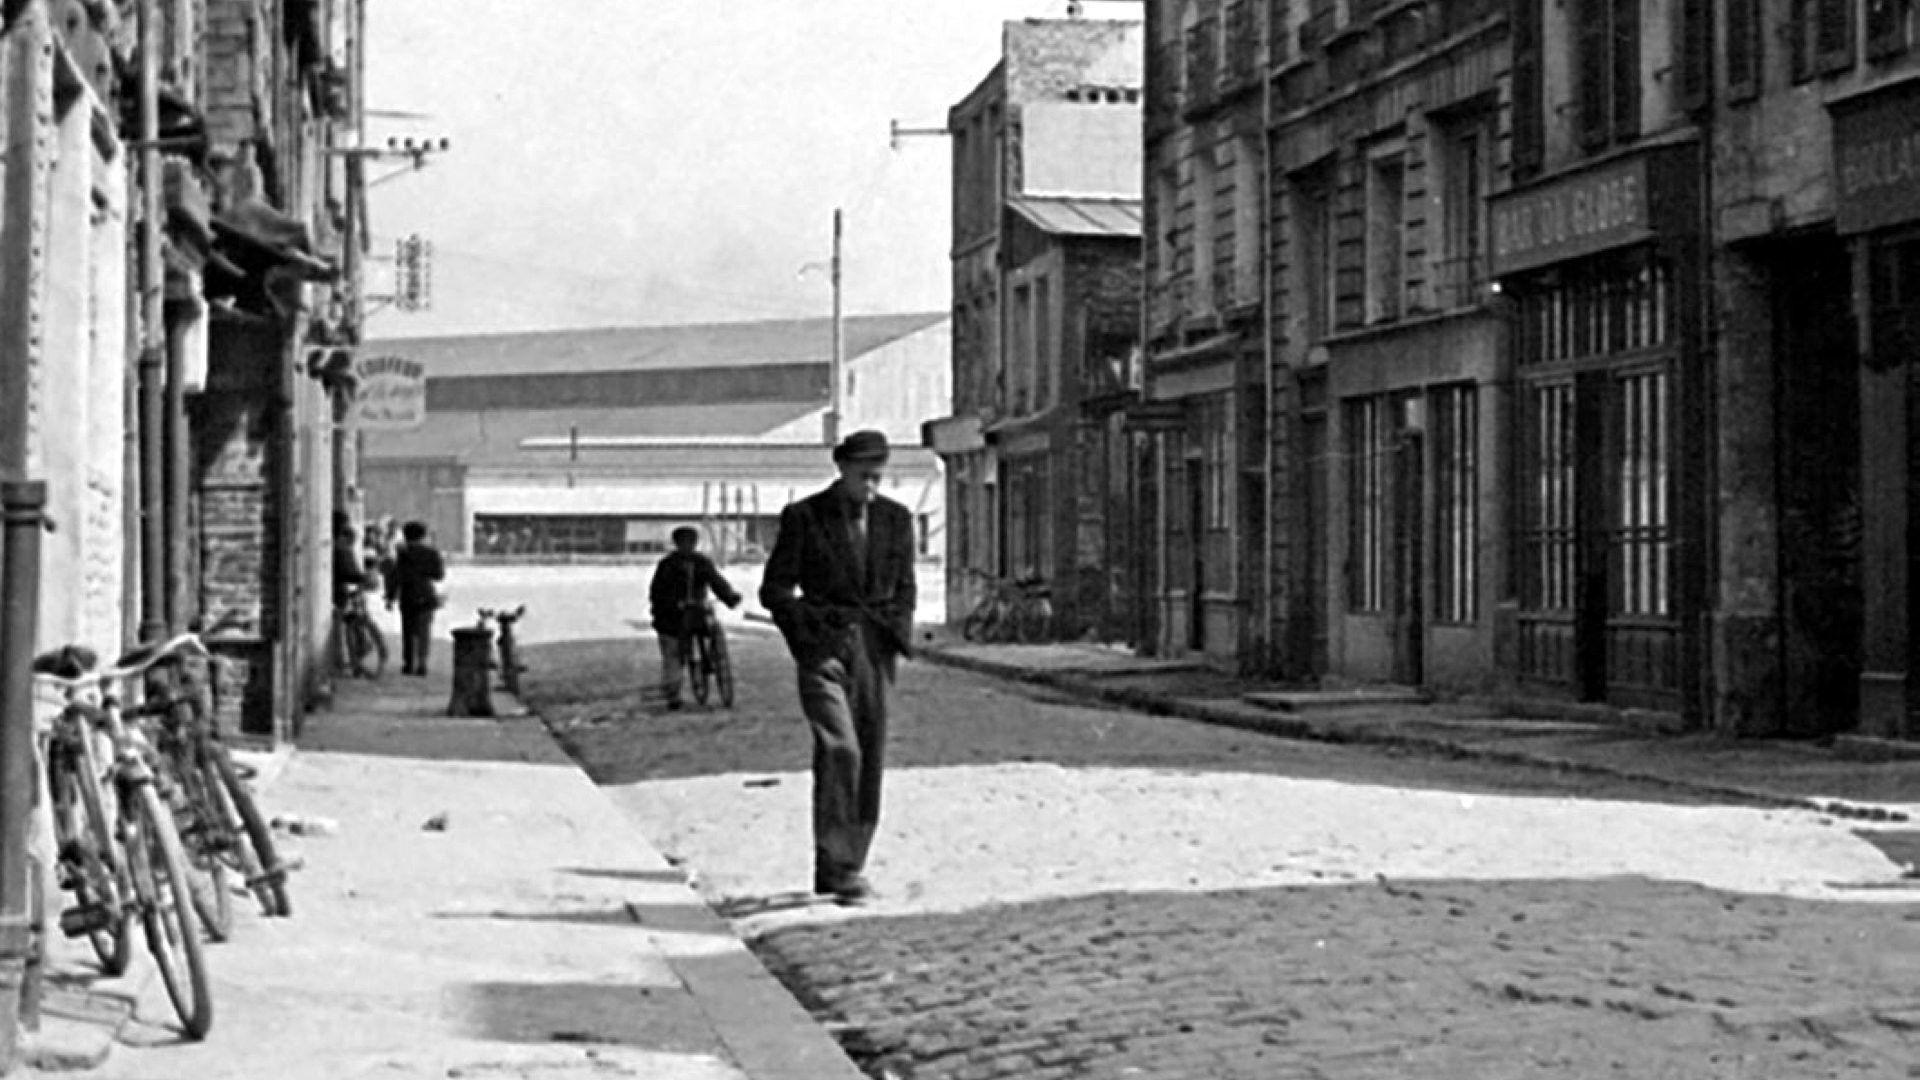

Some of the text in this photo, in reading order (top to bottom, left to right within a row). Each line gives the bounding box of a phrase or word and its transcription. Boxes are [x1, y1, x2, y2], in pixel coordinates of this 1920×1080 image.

[1498, 174, 1639, 256] BAR DU GLOBE
